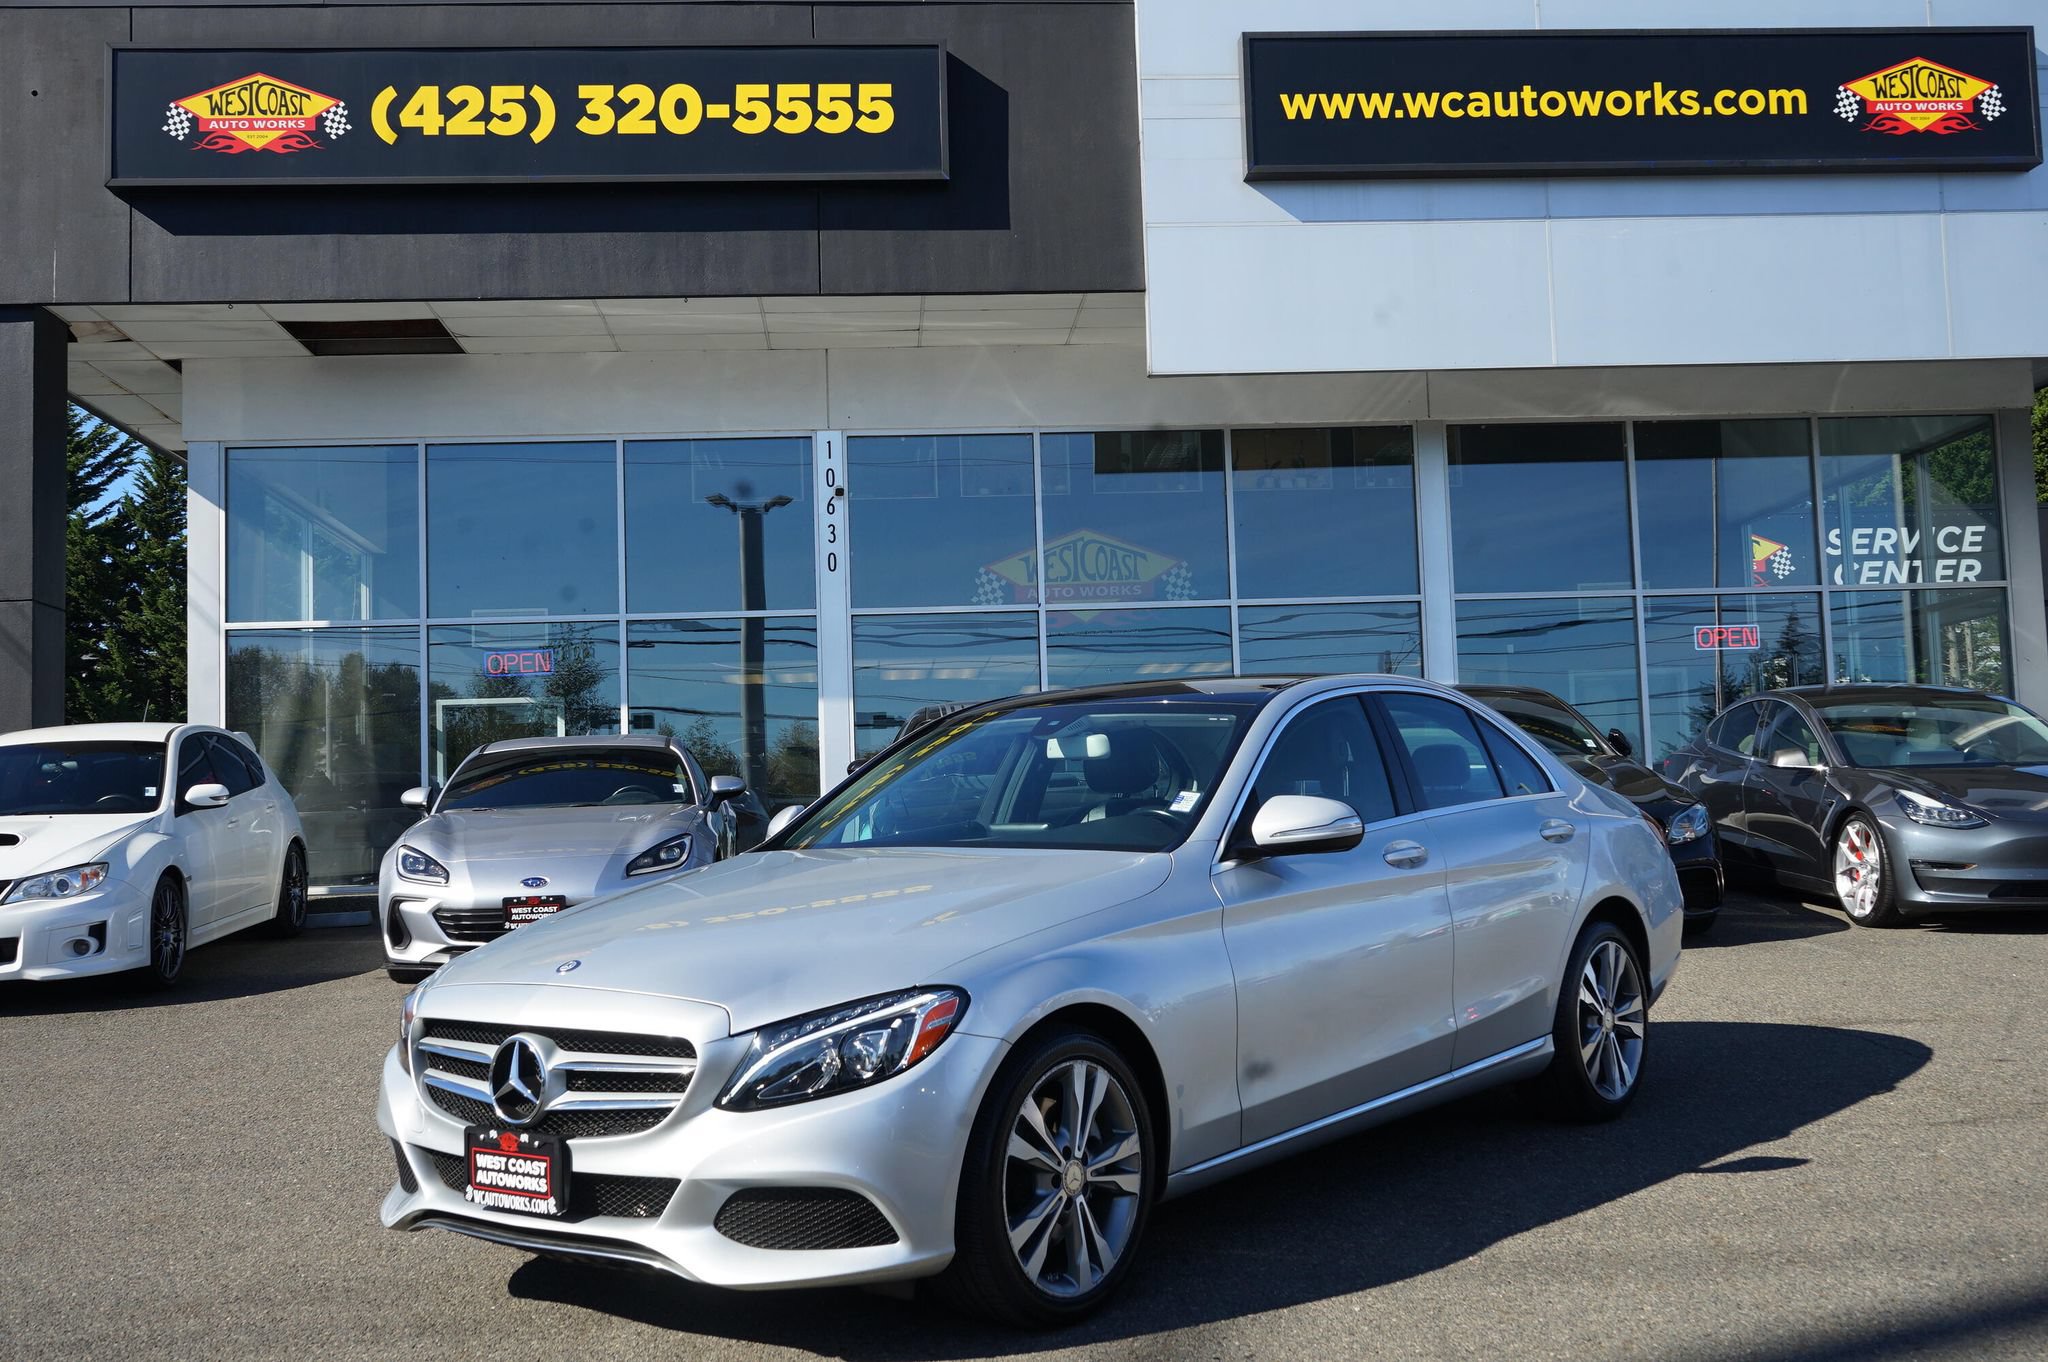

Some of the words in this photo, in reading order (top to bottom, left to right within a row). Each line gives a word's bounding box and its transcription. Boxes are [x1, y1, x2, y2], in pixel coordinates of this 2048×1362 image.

[1279, 81, 1808, 120] www.wcautoworks.com
[1875, 102, 1912, 111] AUTO
[1915, 102, 1964, 111] WORKS
[209, 120, 250, 129] AUTO
[253, 120, 306, 129] WORKS
[371, 84, 556, 145] (425)
[575, 83, 895, 135] 320-5555
[826, 440, 837, 572] 10630
[1826, 525, 1986, 555] SERVCE
[1079, 584, 1142, 597] WORKS
[1698, 627, 1757, 648] OPEN
[487, 653, 550, 674] OPEN
[475, 1154, 507, 1171] WEST
[507, 1158, 547, 1176] COAST
[476, 1170, 548, 1193] AUTOWORKS
[473, 1190, 548, 1214] WCAUTOWORKS.COM
